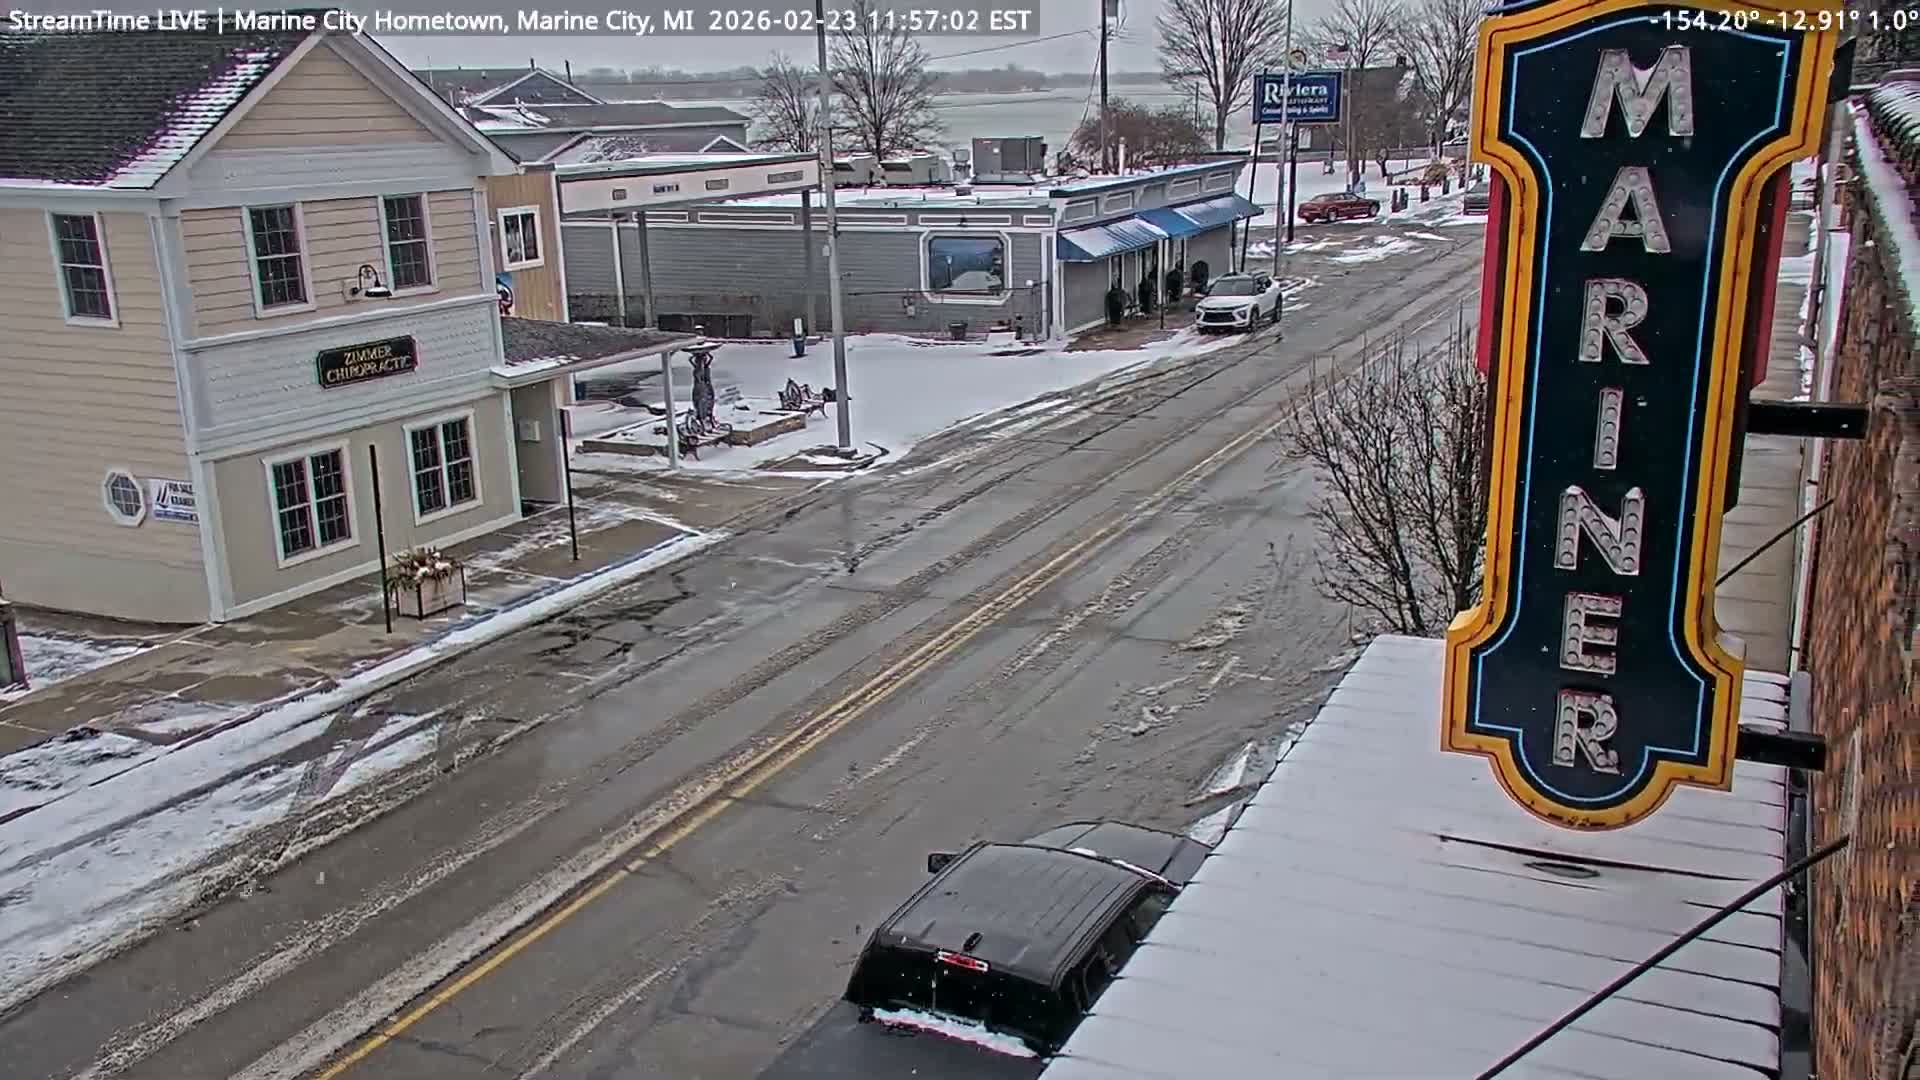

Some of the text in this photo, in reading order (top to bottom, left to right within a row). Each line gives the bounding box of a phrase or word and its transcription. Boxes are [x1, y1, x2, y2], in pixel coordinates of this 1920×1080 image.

[1263, 82, 1328, 104] Riviera
[344, 345, 392, 366] ZIMMER
[326, 355, 412, 382] CHIROPRACTIC
[1554, 44, 1694, 775] MARINER
